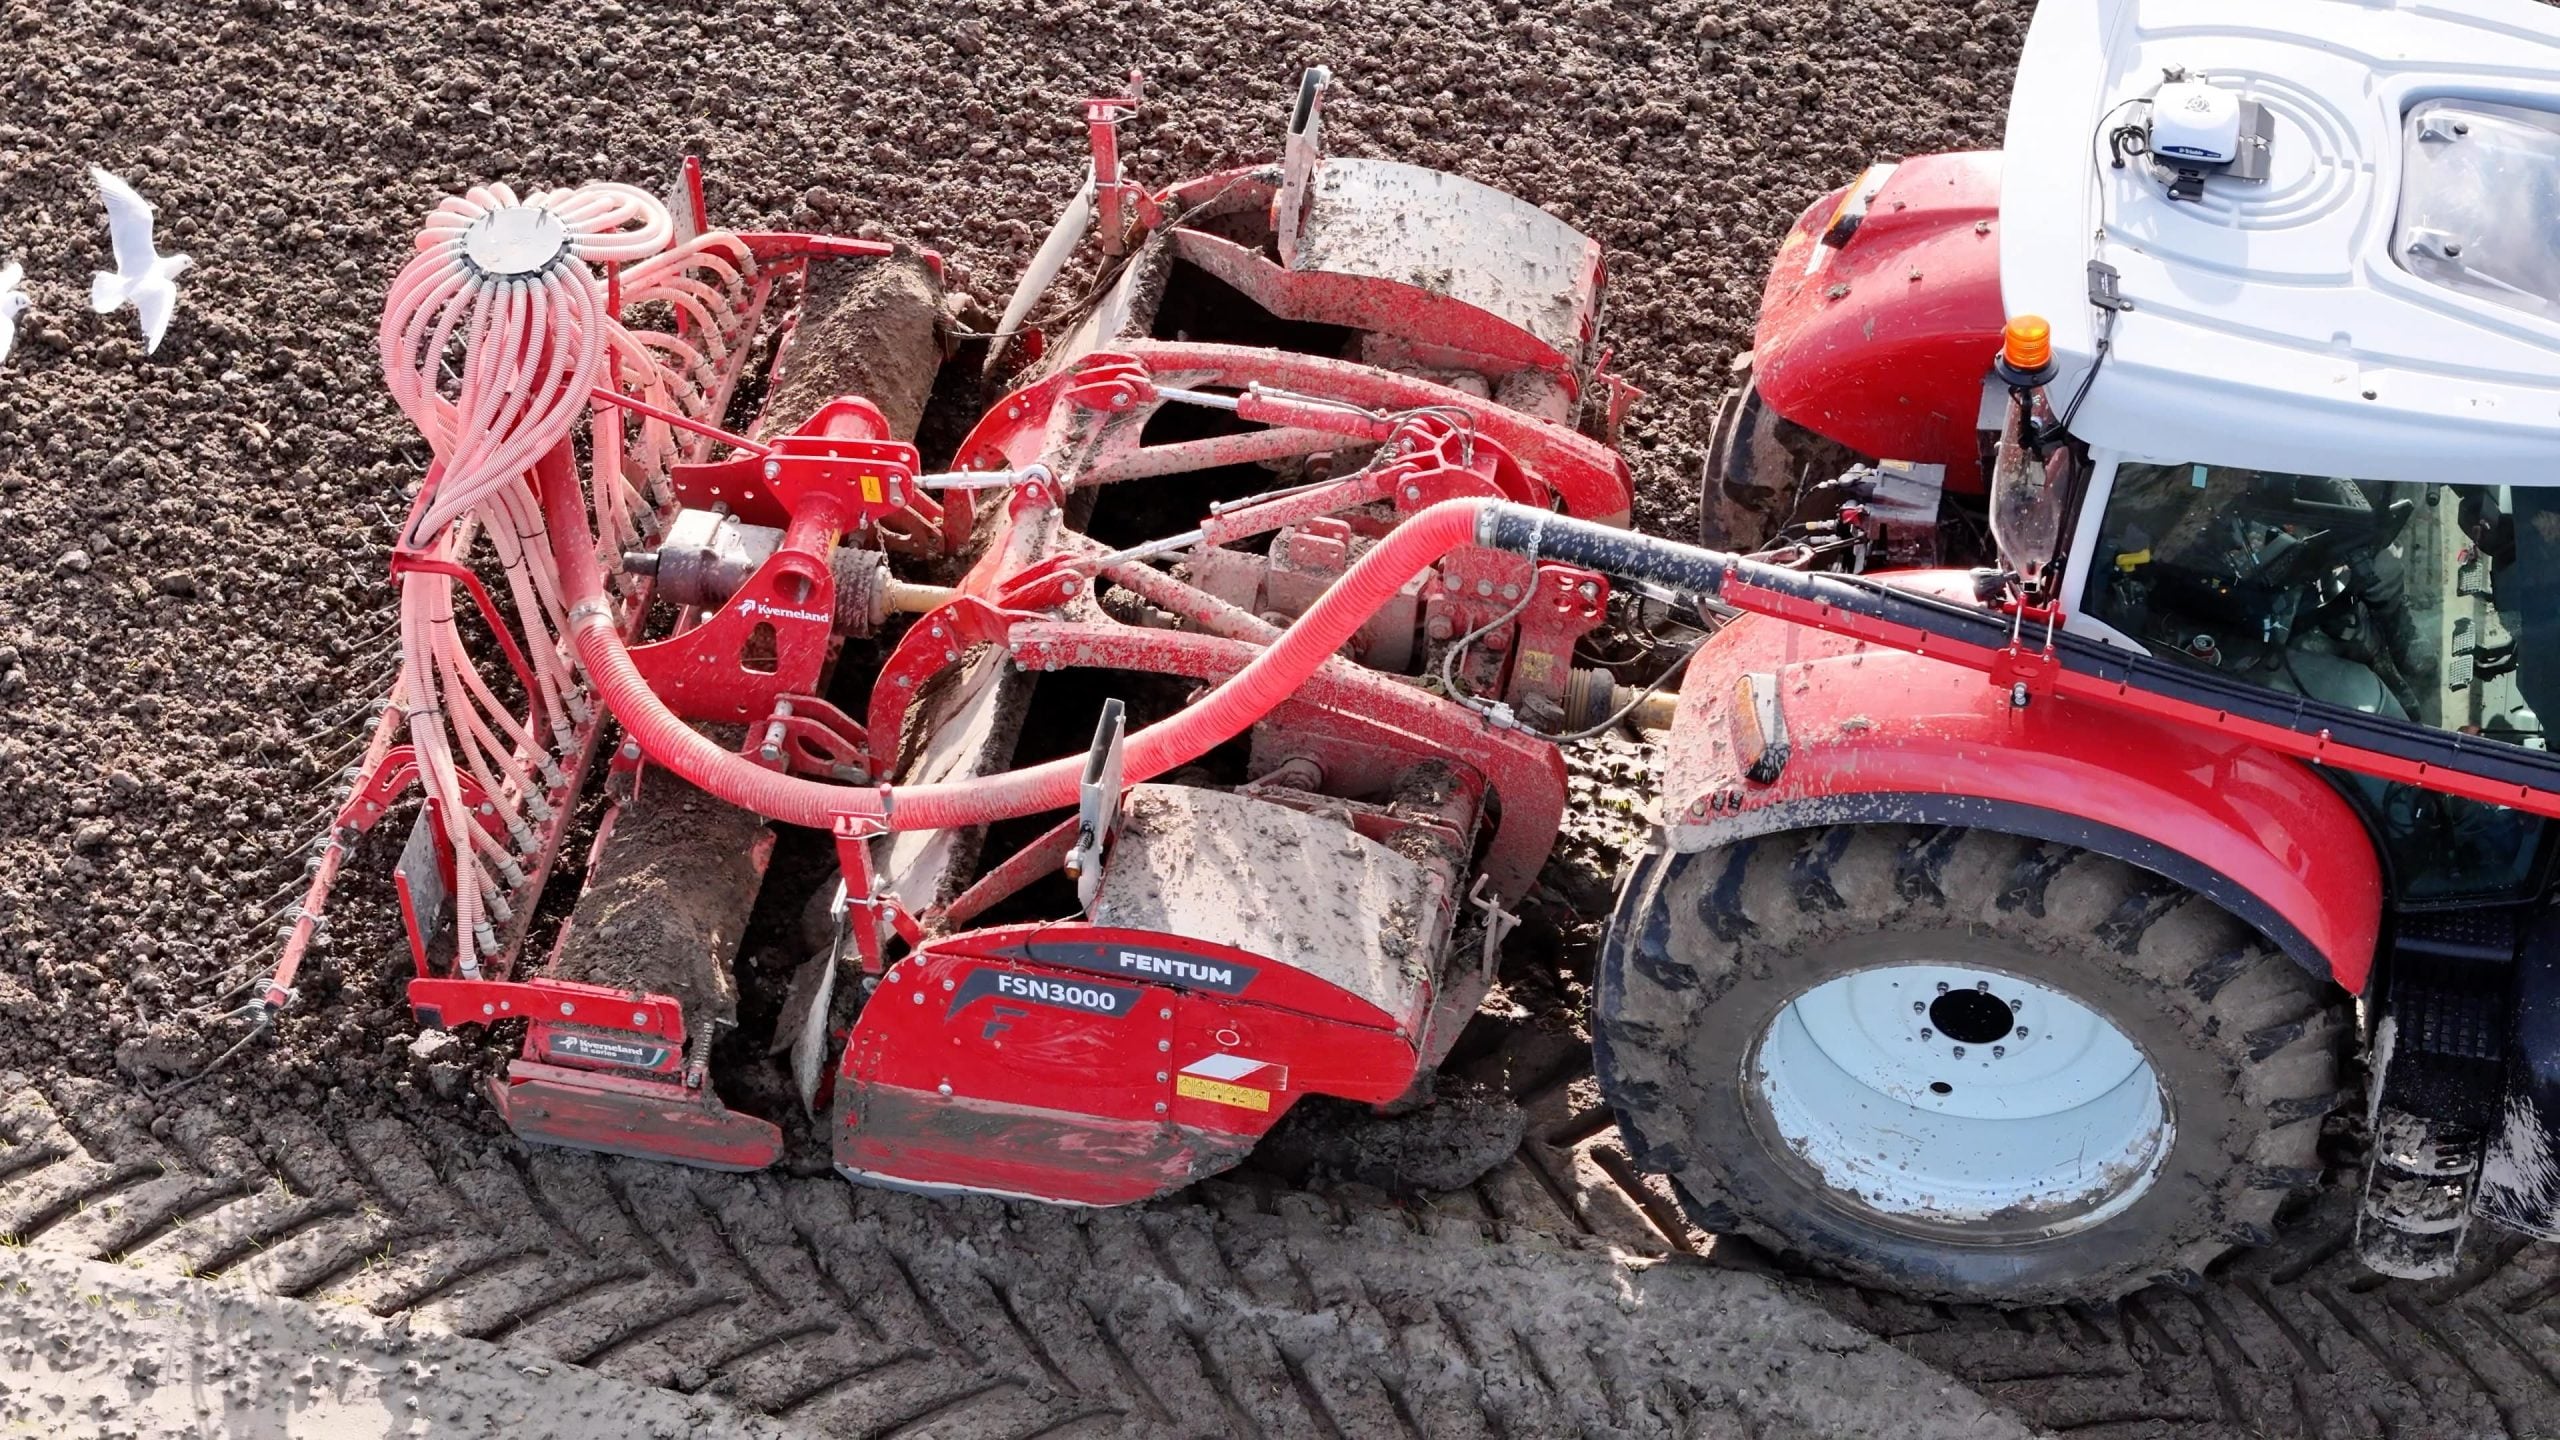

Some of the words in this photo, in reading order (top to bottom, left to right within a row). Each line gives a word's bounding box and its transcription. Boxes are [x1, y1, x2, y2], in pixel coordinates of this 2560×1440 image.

[758, 604, 829, 622] Kverneland
[1119, 951, 1232, 985] FENTUM
[998, 974, 1116, 1011] FSN3000
[580, 1039, 643, 1056] Kverneland
